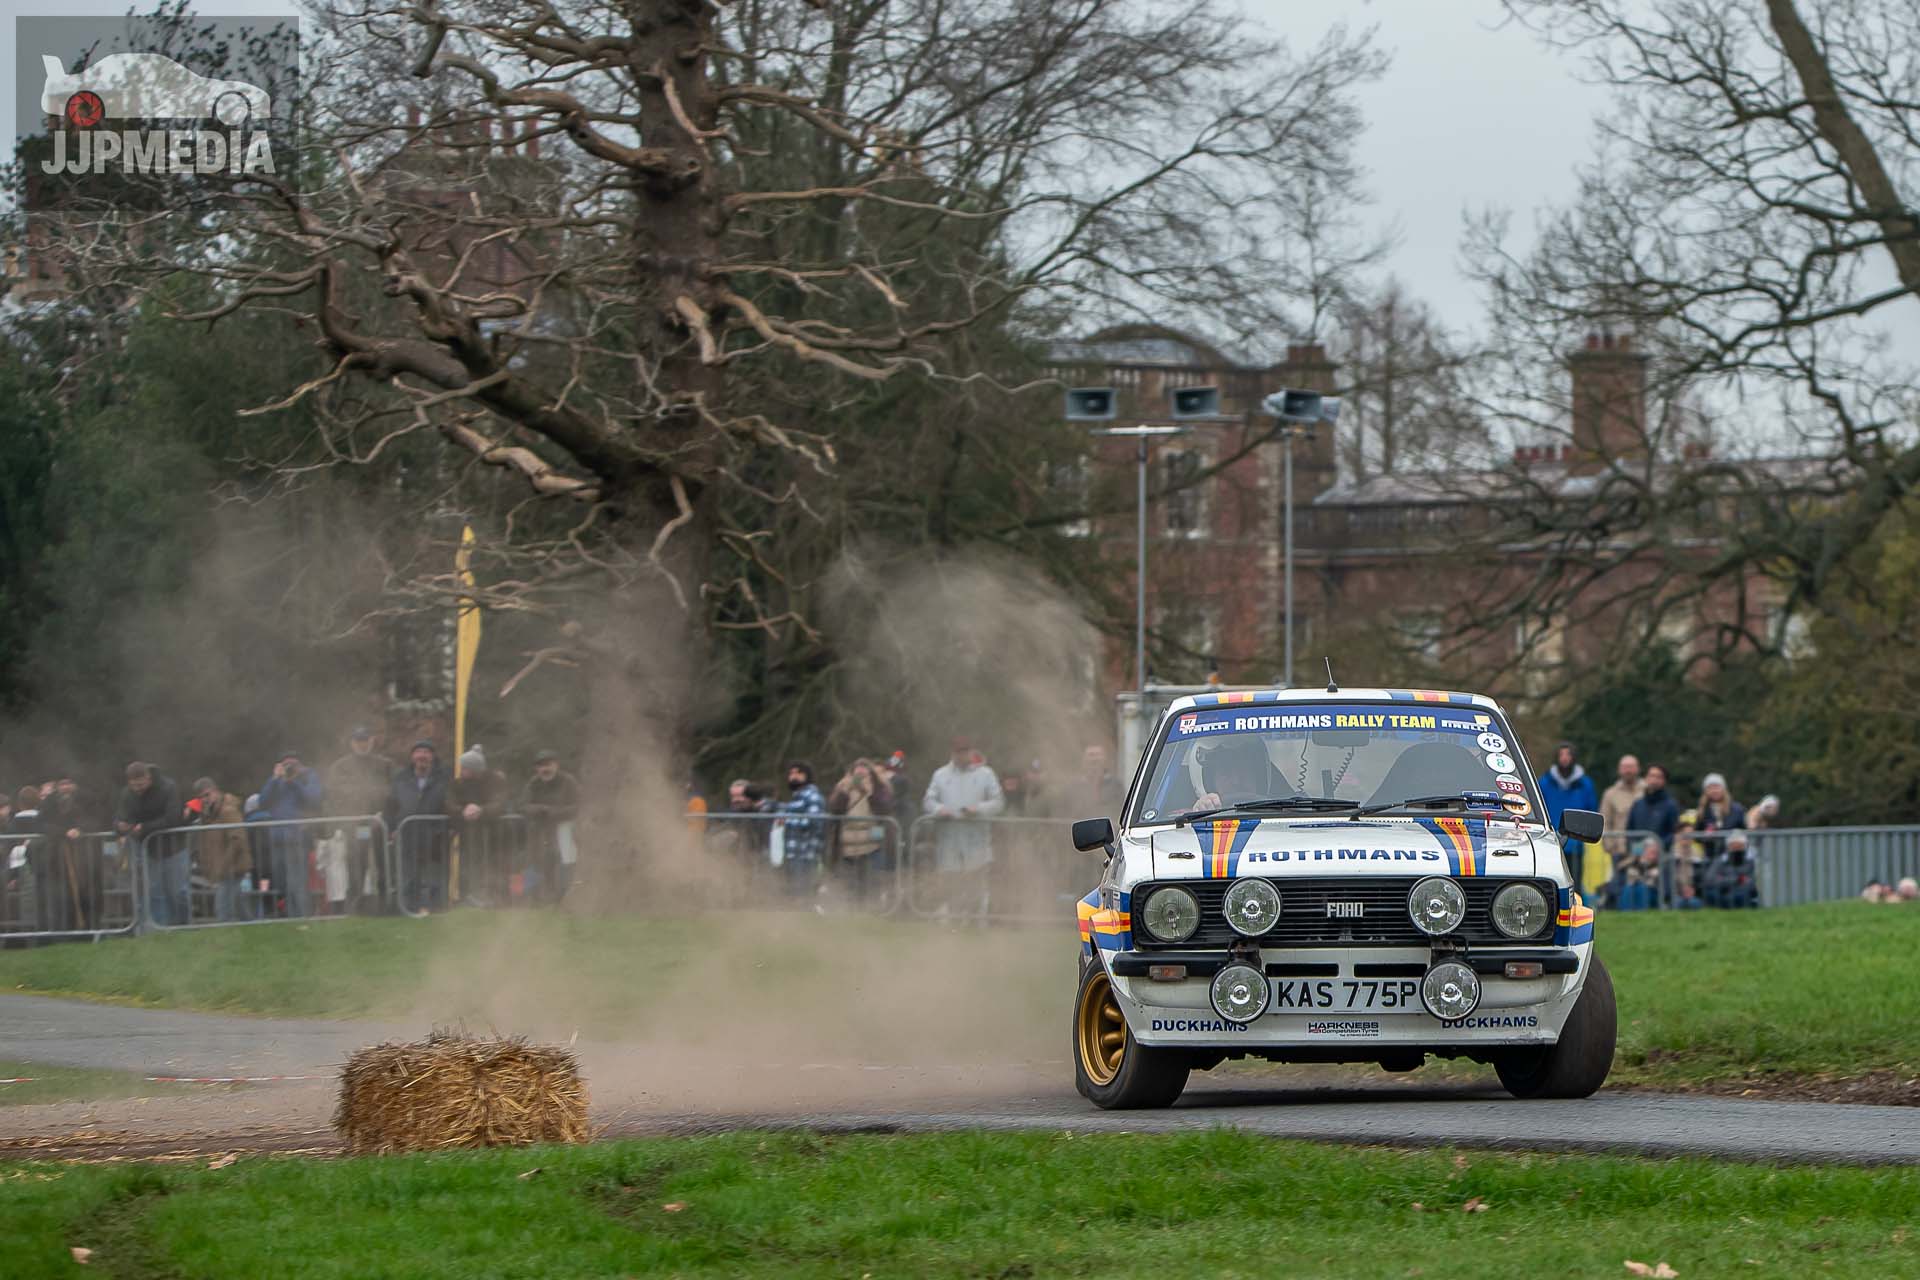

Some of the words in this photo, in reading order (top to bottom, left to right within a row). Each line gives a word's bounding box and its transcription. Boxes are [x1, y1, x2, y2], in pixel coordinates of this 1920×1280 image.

[1235, 714, 1331, 730] ROTHMANS
[1336, 714, 1386, 728] RALLY
[1389, 714, 1436, 729] TEAM
[1482, 737, 1502, 749] 45
[1496, 758, 1505, 768] 8
[1500, 782, 1522, 793] 330
[1248, 849, 1441, 863] ROTHMANS
[1327, 902, 1364, 918] FORD
[1277, 981, 1333, 1008] KAS
[1343, 981, 1417, 1008] 775P
[1152, 1020, 1249, 1032] DUCKHAMS
[1441, 1016, 1538, 1029] DUCKHAMS
